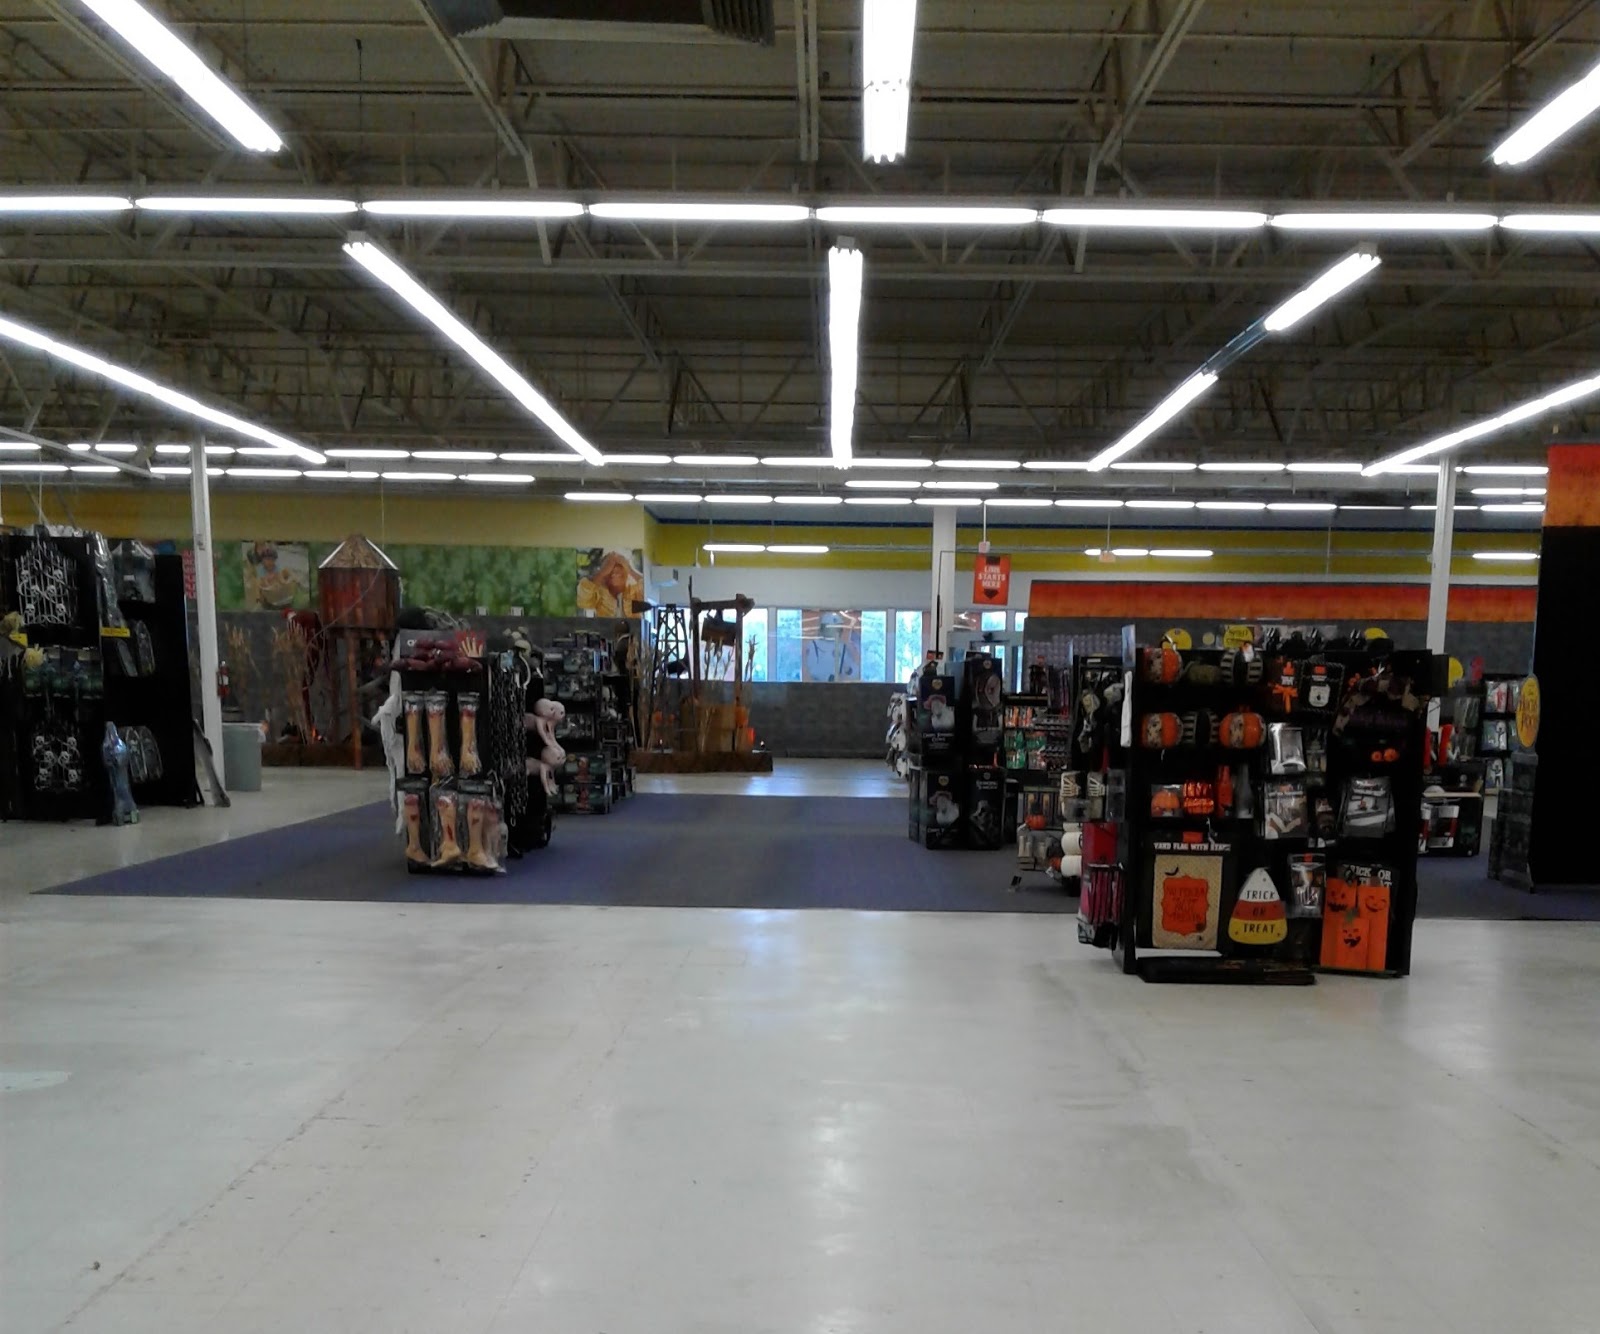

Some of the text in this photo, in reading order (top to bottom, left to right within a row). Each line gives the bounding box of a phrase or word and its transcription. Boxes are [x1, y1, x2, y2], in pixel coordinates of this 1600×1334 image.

[978, 573, 1006, 581] STARTS
[982, 580, 1001, 588] HERE
[1153, 842, 1172, 850] YARD
[1172, 842, 1189, 850] FLAG
[1190, 842, 1209, 851] WITH
[1377, 868, 1392, 881] OR
[1246, 890, 1275, 900] TRICK
[1252, 907, 1265, 916] OR
[1243, 923, 1275, 933] TREAT
